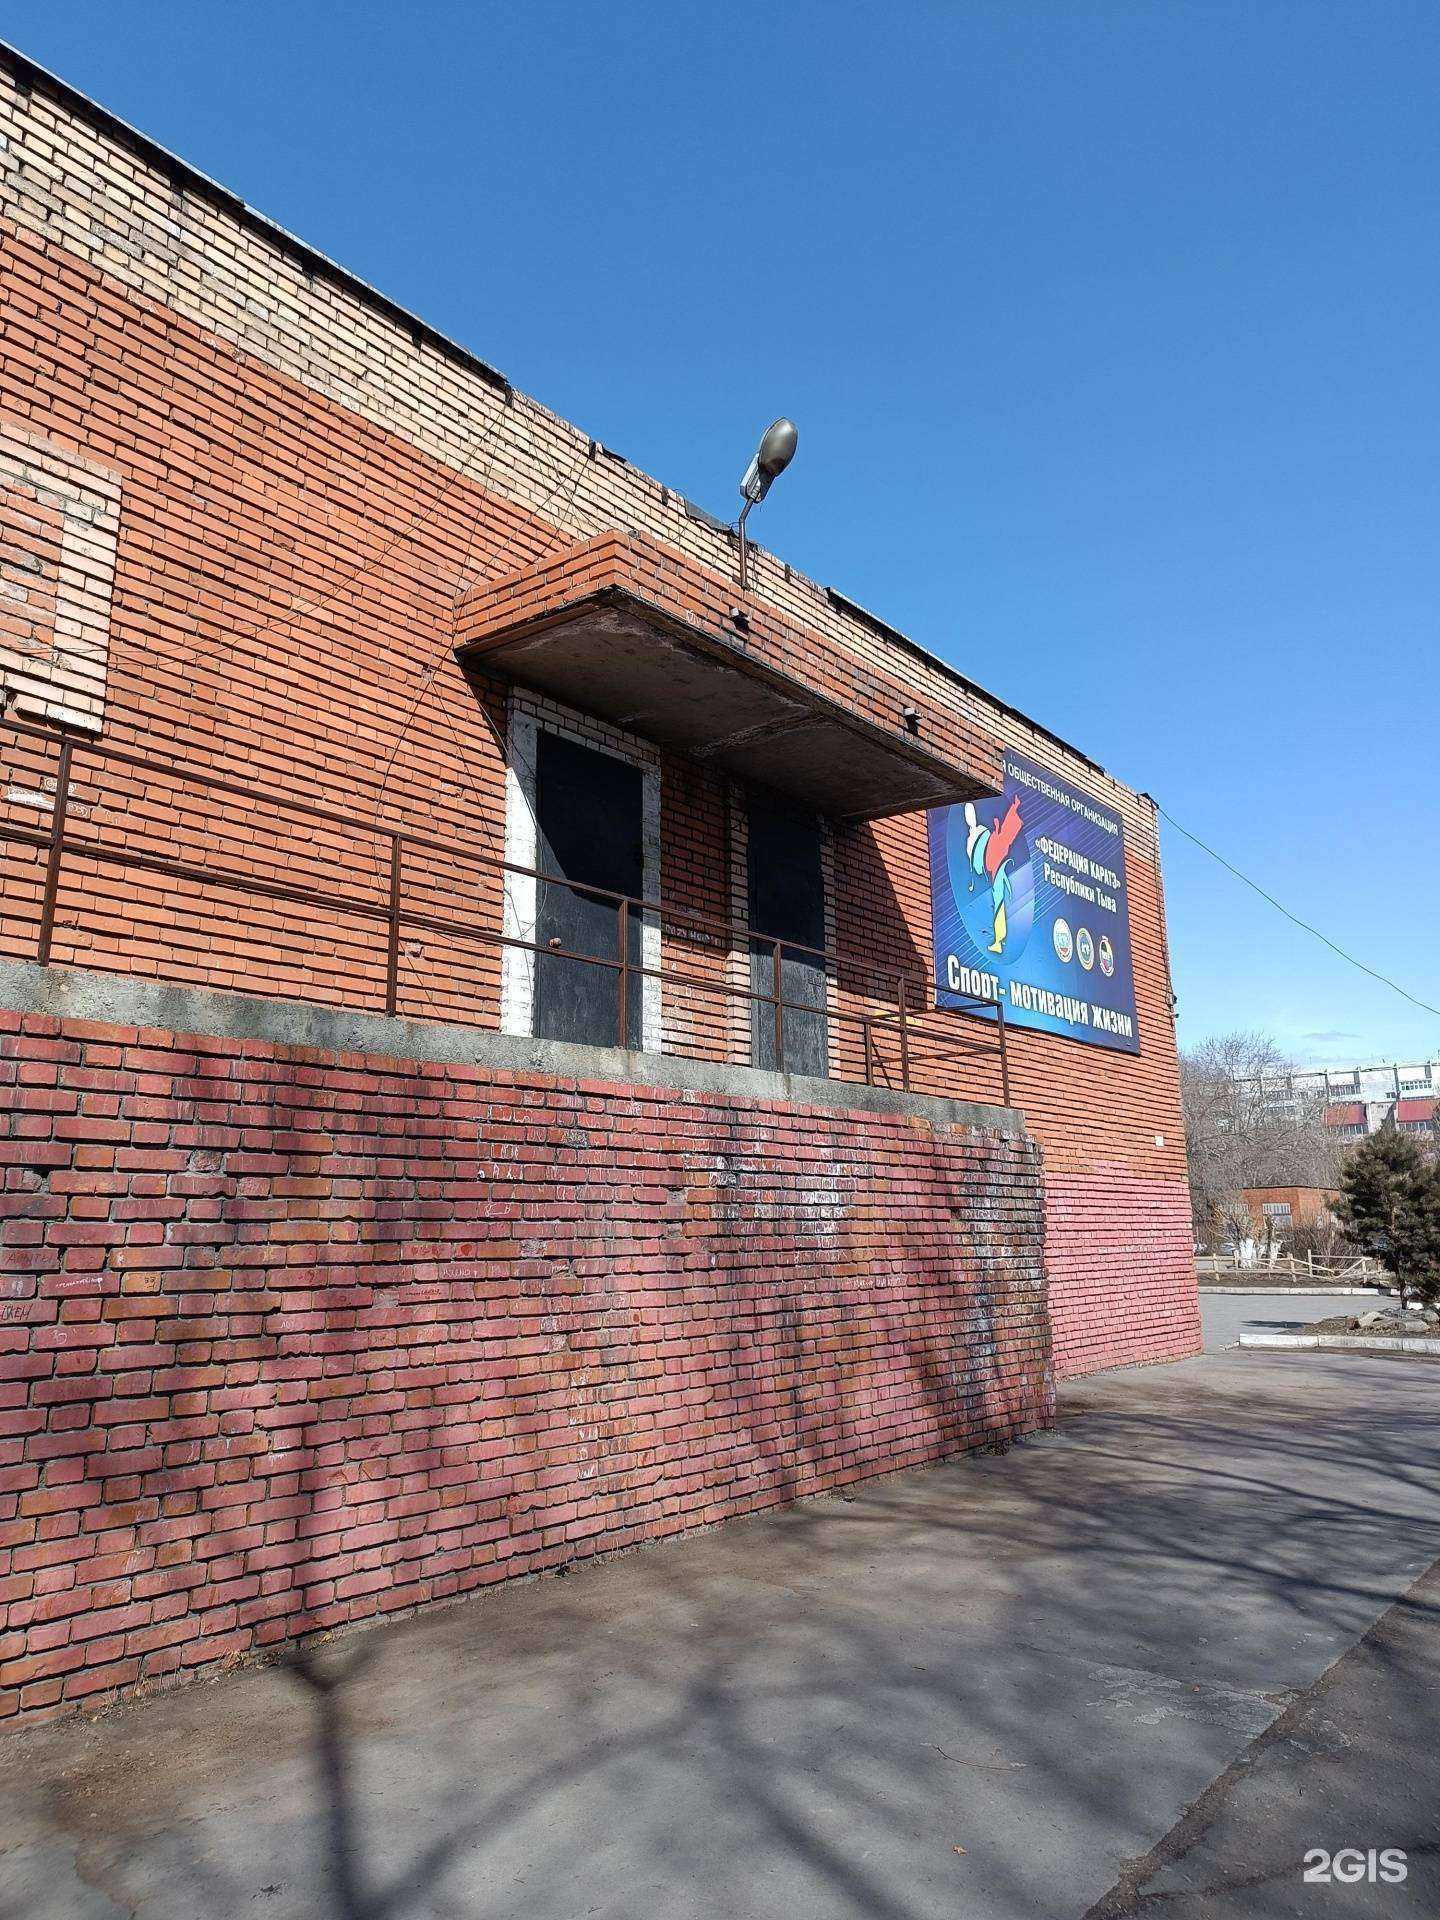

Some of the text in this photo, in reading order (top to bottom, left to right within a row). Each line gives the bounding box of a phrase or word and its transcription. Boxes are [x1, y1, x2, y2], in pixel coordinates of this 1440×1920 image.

[1008, 763, 1119, 836] ОБЩЕСТВЕННАЯ ОРГАНИЗАЦИЯ
[1044, 861, 1117, 913] Республики Тыва
[1010, 980, 1089, 1025] мотивация
[1092, 1004, 1133, 1037] жизни
